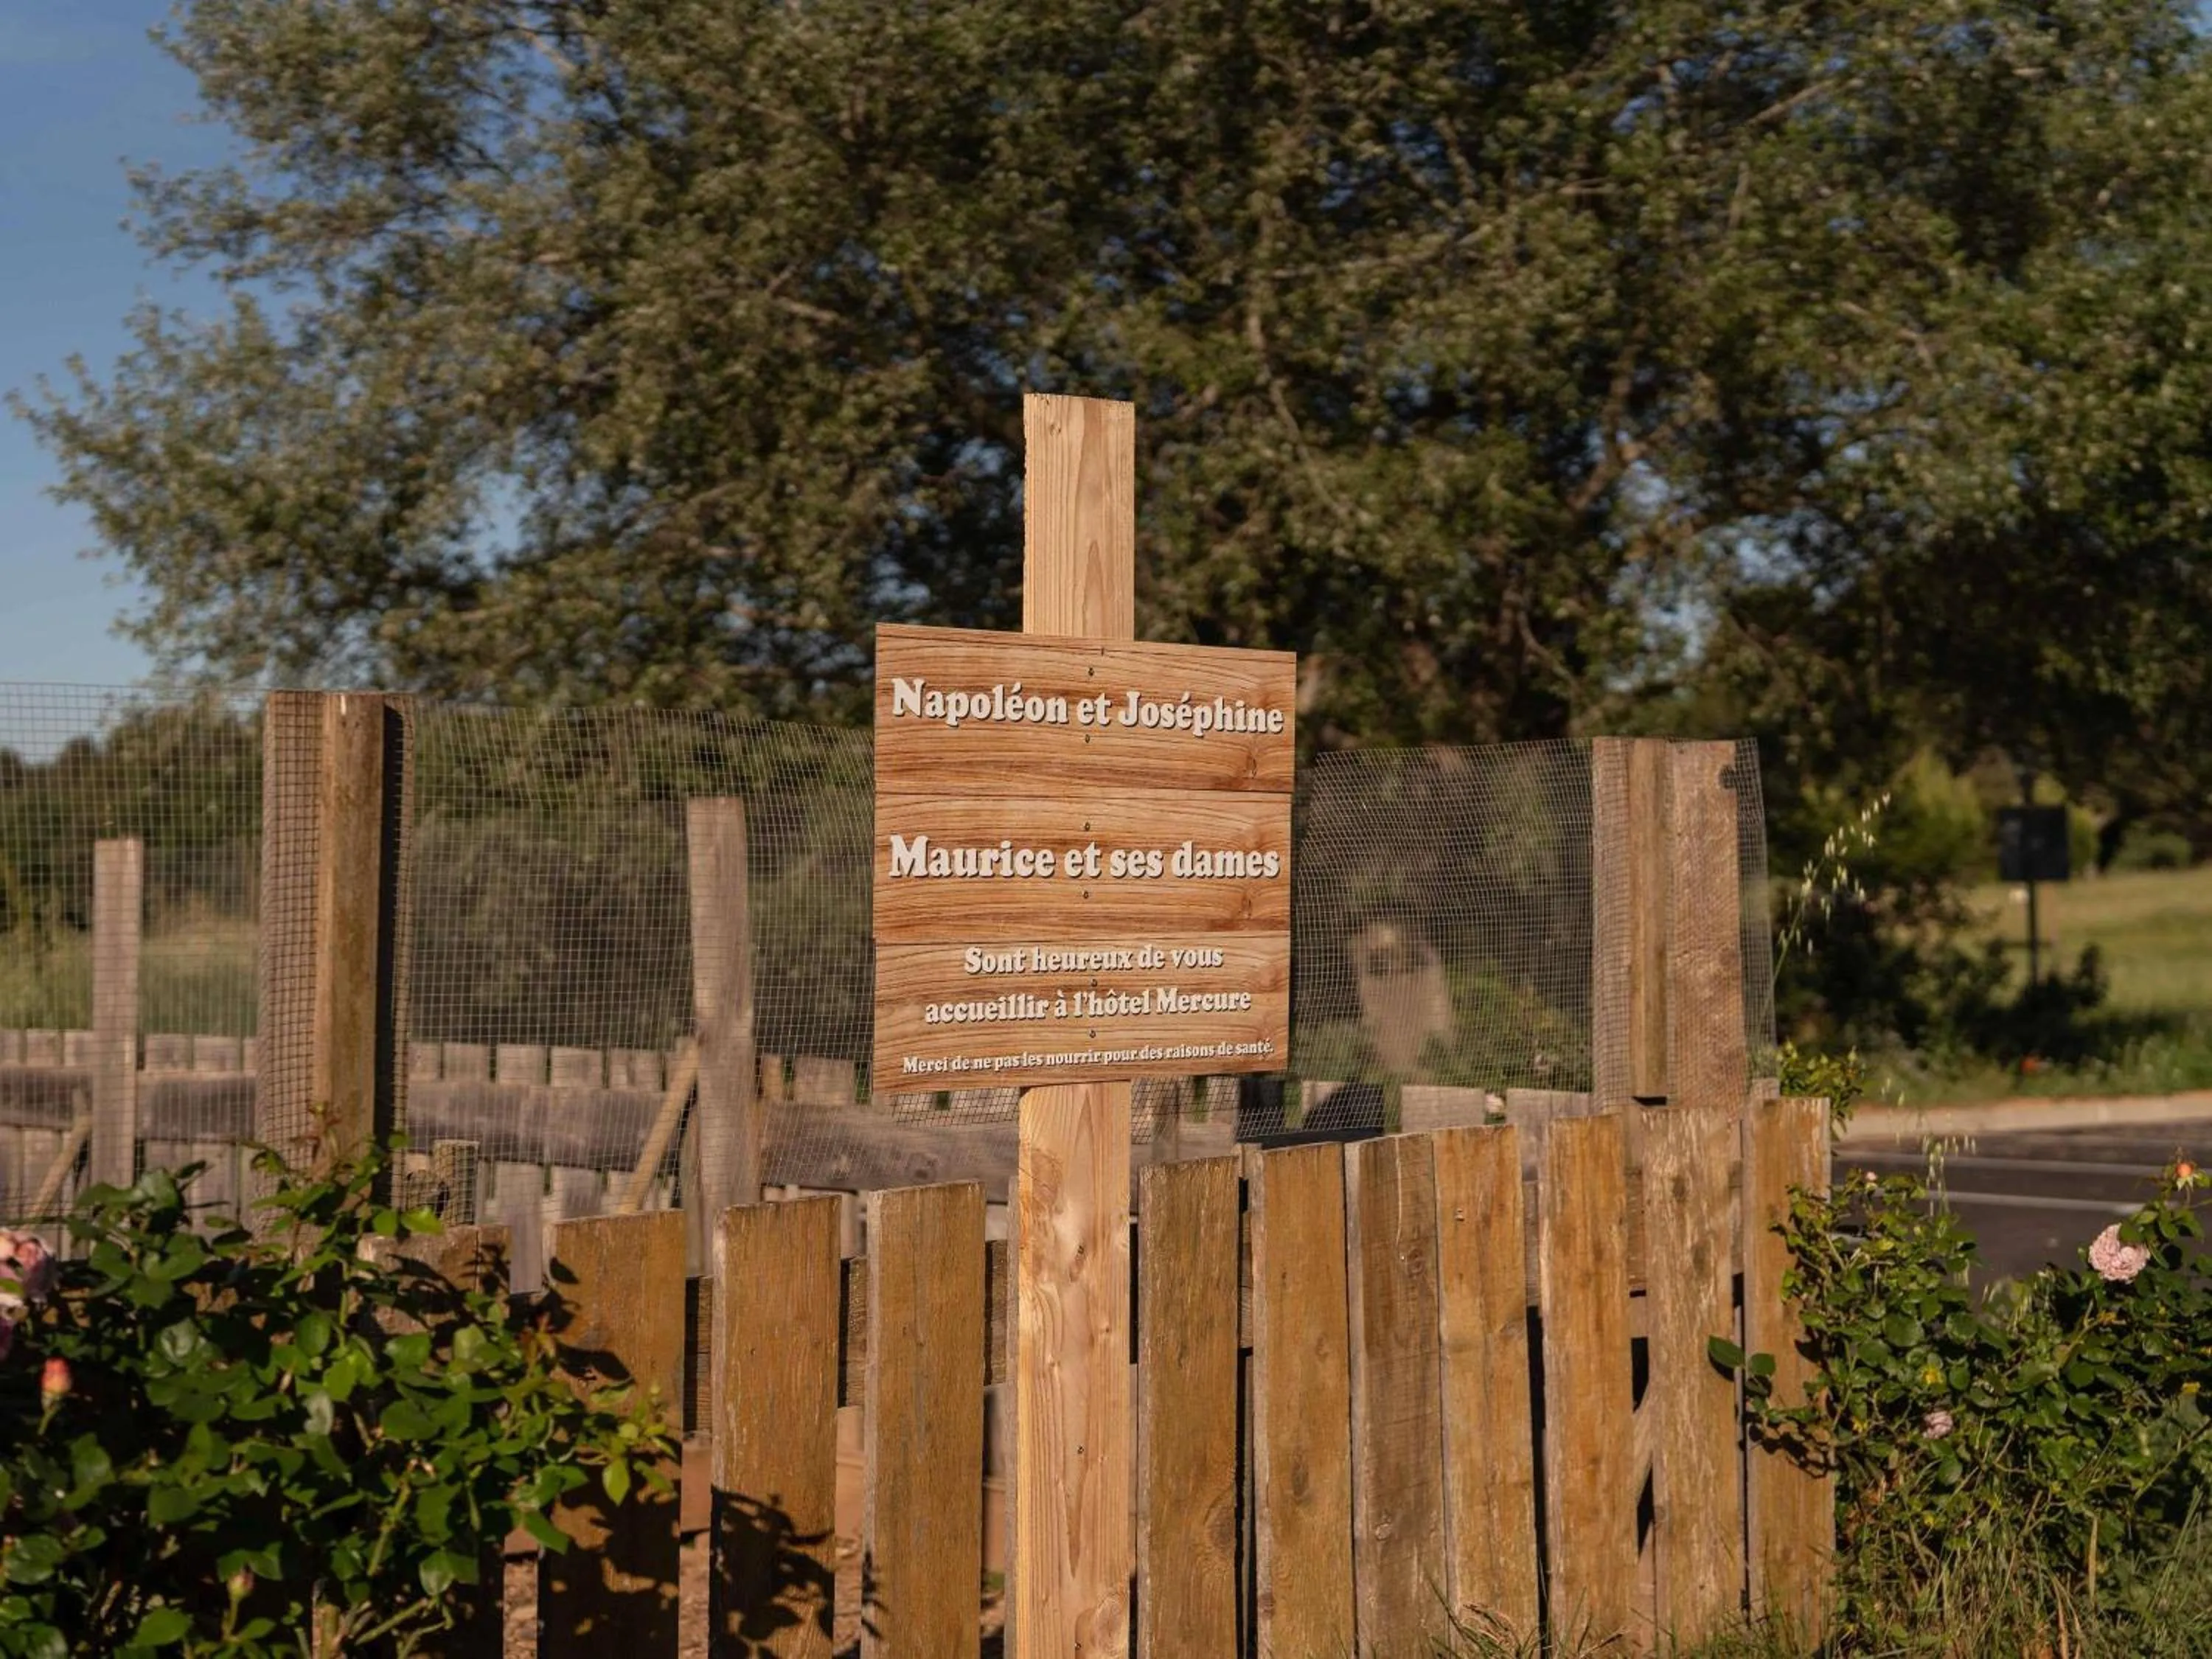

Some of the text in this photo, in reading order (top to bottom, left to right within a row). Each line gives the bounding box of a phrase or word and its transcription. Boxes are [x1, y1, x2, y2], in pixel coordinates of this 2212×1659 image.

[891, 678, 1284, 736] Napoléon et Joséphine
[889, 835, 1279, 878] Maurice et ses dames
[964, 944, 1223, 973] Sont heureux de vous
[925, 987, 1251, 1023] accueillir à l'hôtel Mercure
[902, 1057, 947, 1074] Merci
[952, 1056, 970, 1071] de
[973, 1058, 992, 1070] ne
[995, 1056, 1019, 1071] pas
[1022, 1053, 1043, 1067] les
[1046, 1050, 1102, 1065] nourrir
[1104, 1048, 1140, 1065] pour
[1141, 1045, 1163, 1060] des
[1166, 1043, 1215, 1058] raisons
[1218, 1040, 1234, 1055] de
